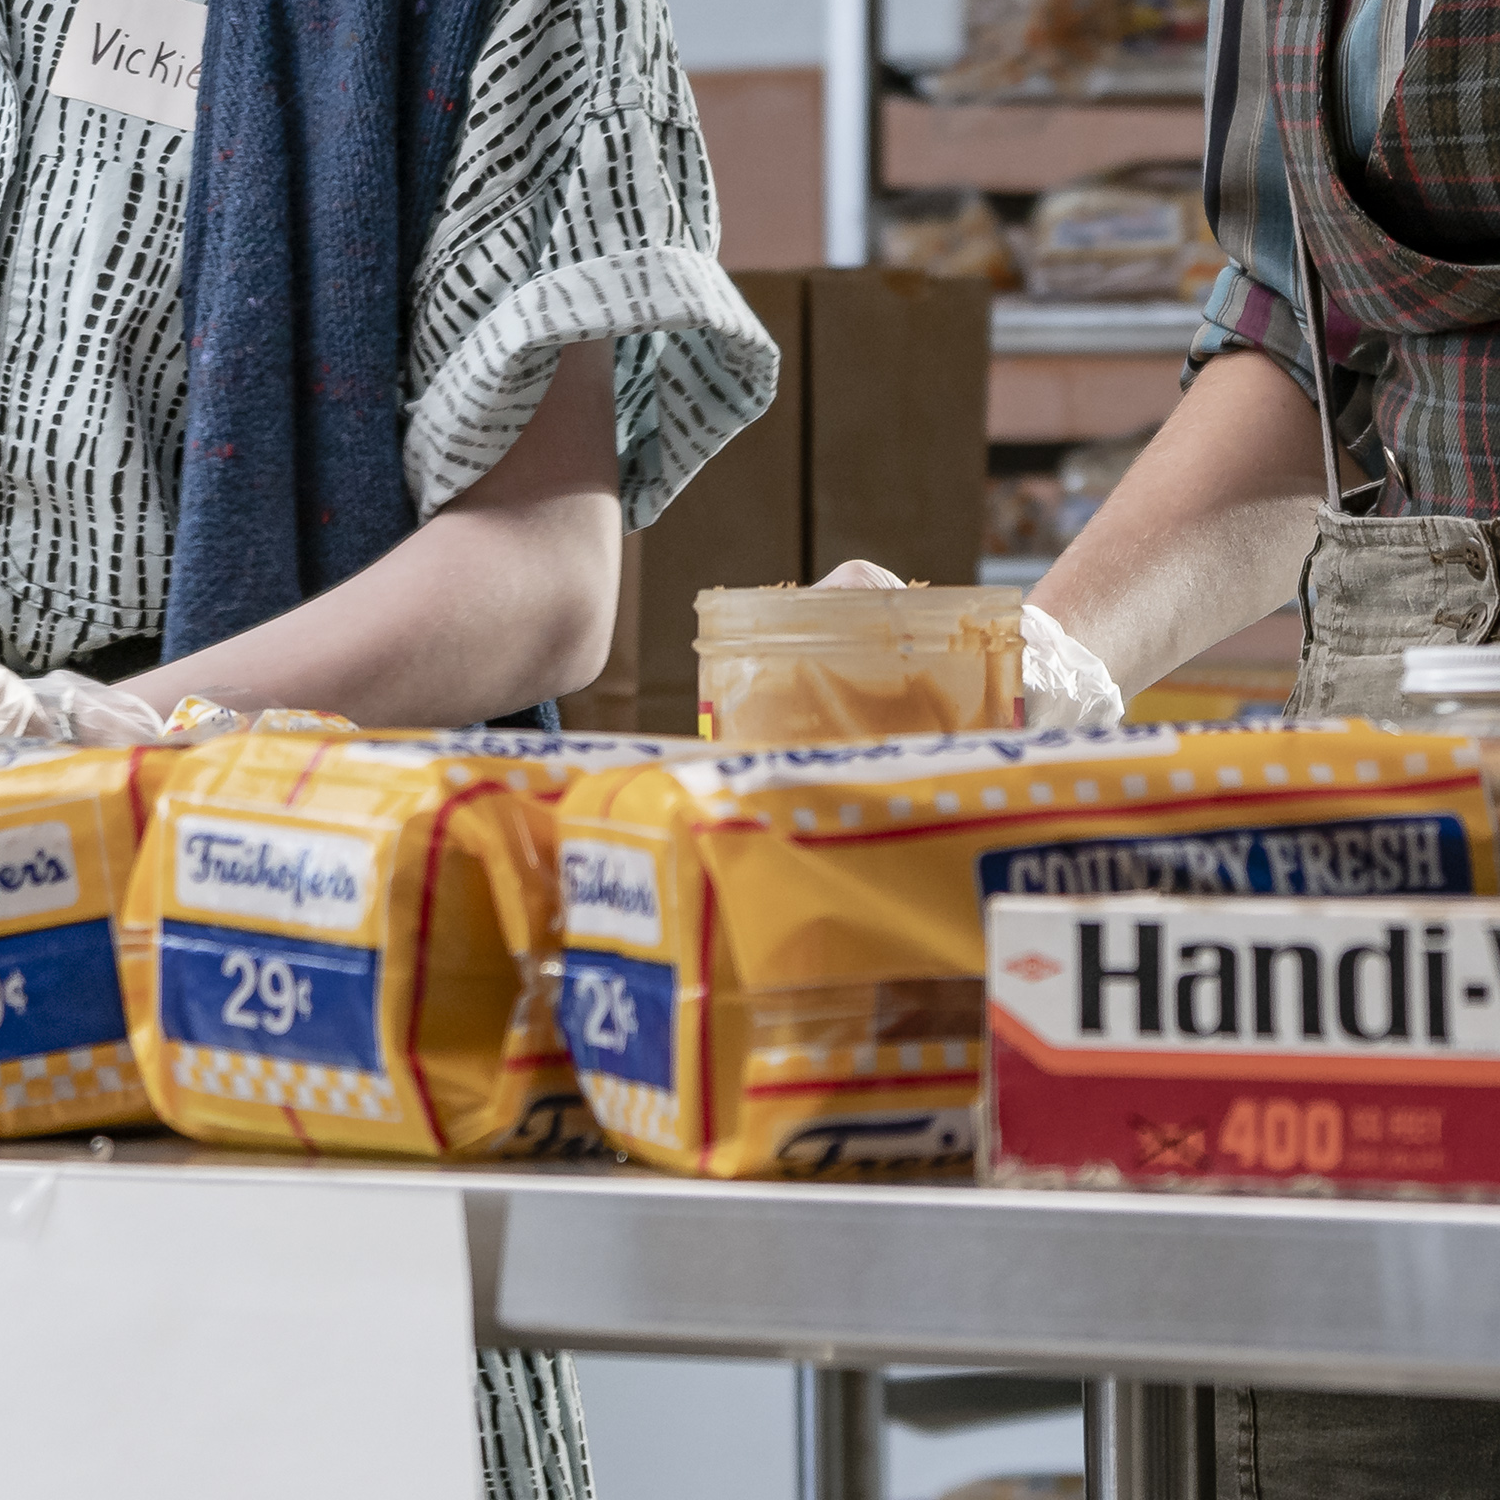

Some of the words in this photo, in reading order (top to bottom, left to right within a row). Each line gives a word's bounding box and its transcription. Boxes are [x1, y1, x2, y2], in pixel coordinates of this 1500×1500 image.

[1009, 836, 1252, 895] COUNTRY
[1263, 820, 1448, 895] FRESH
[1219, 1098, 1345, 1172] 400
